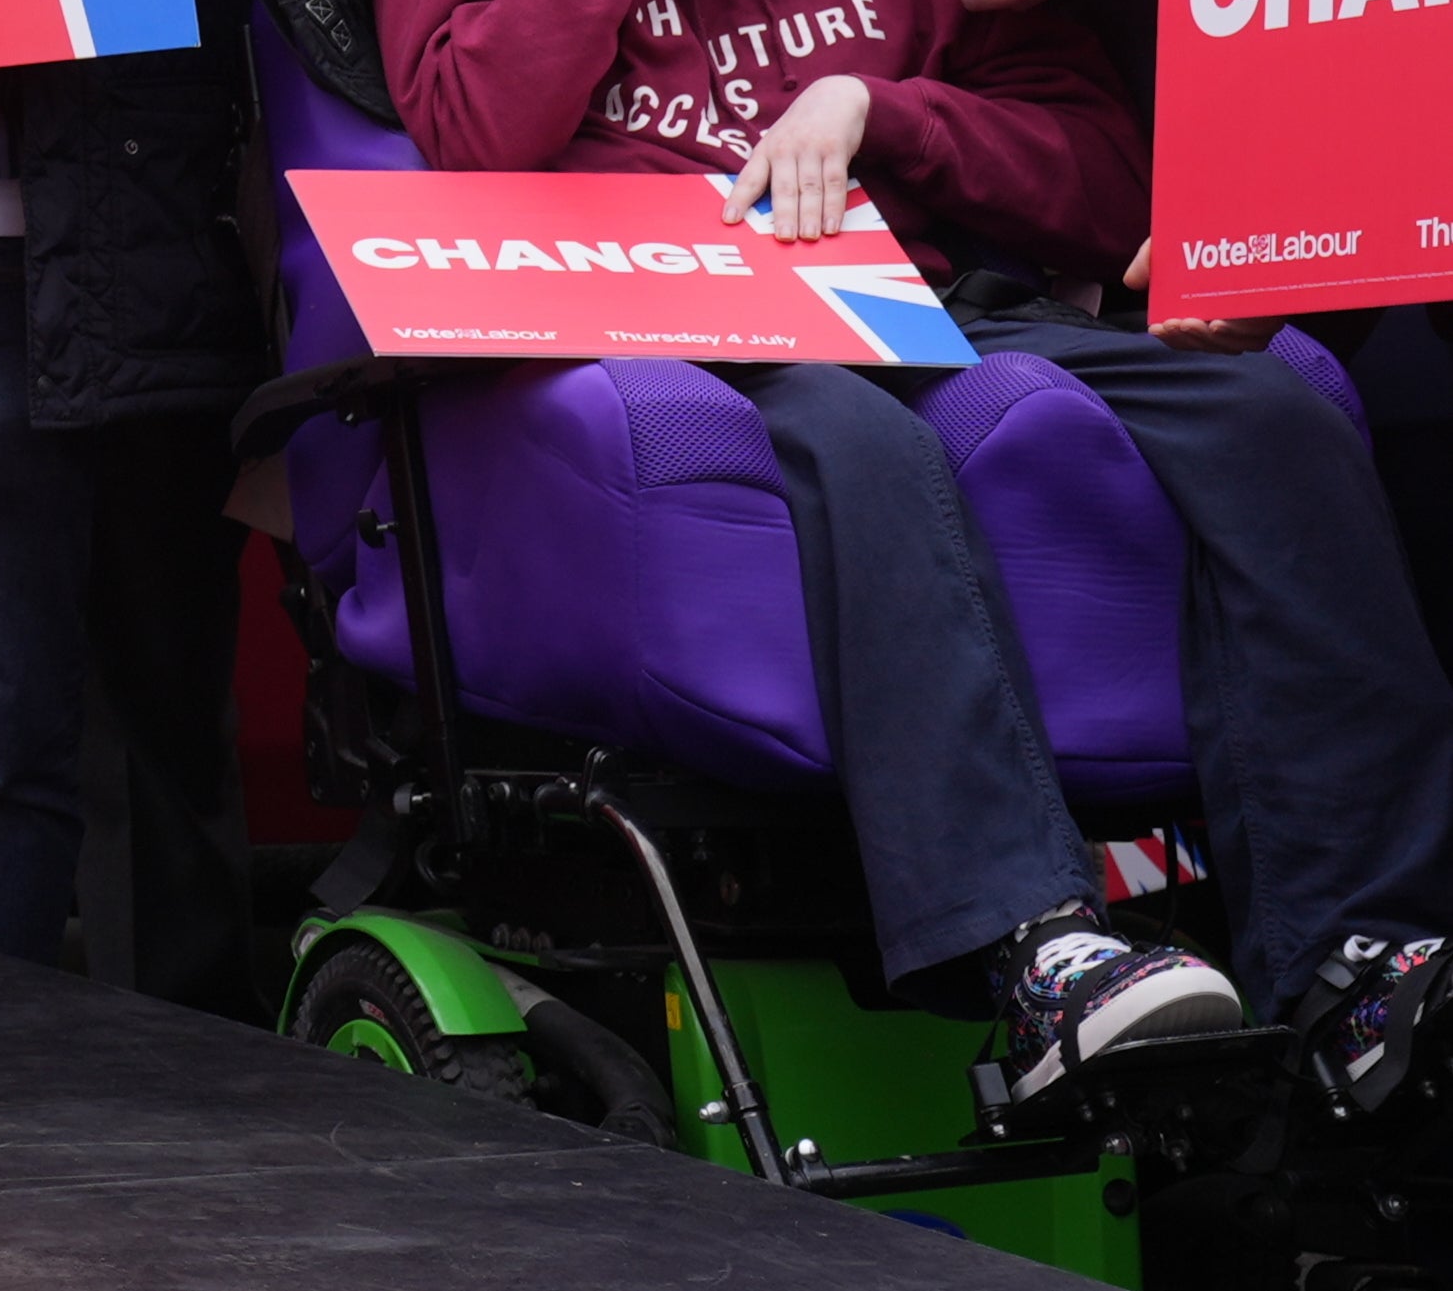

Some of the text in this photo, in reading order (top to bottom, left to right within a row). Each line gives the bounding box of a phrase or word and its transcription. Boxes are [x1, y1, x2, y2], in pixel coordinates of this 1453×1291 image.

[352, 238, 753, 275] CHANGE
[1183, 230, 1362, 269] Vote Labour
[393, 328, 796, 348] Vote Labour Thursday 4 July
